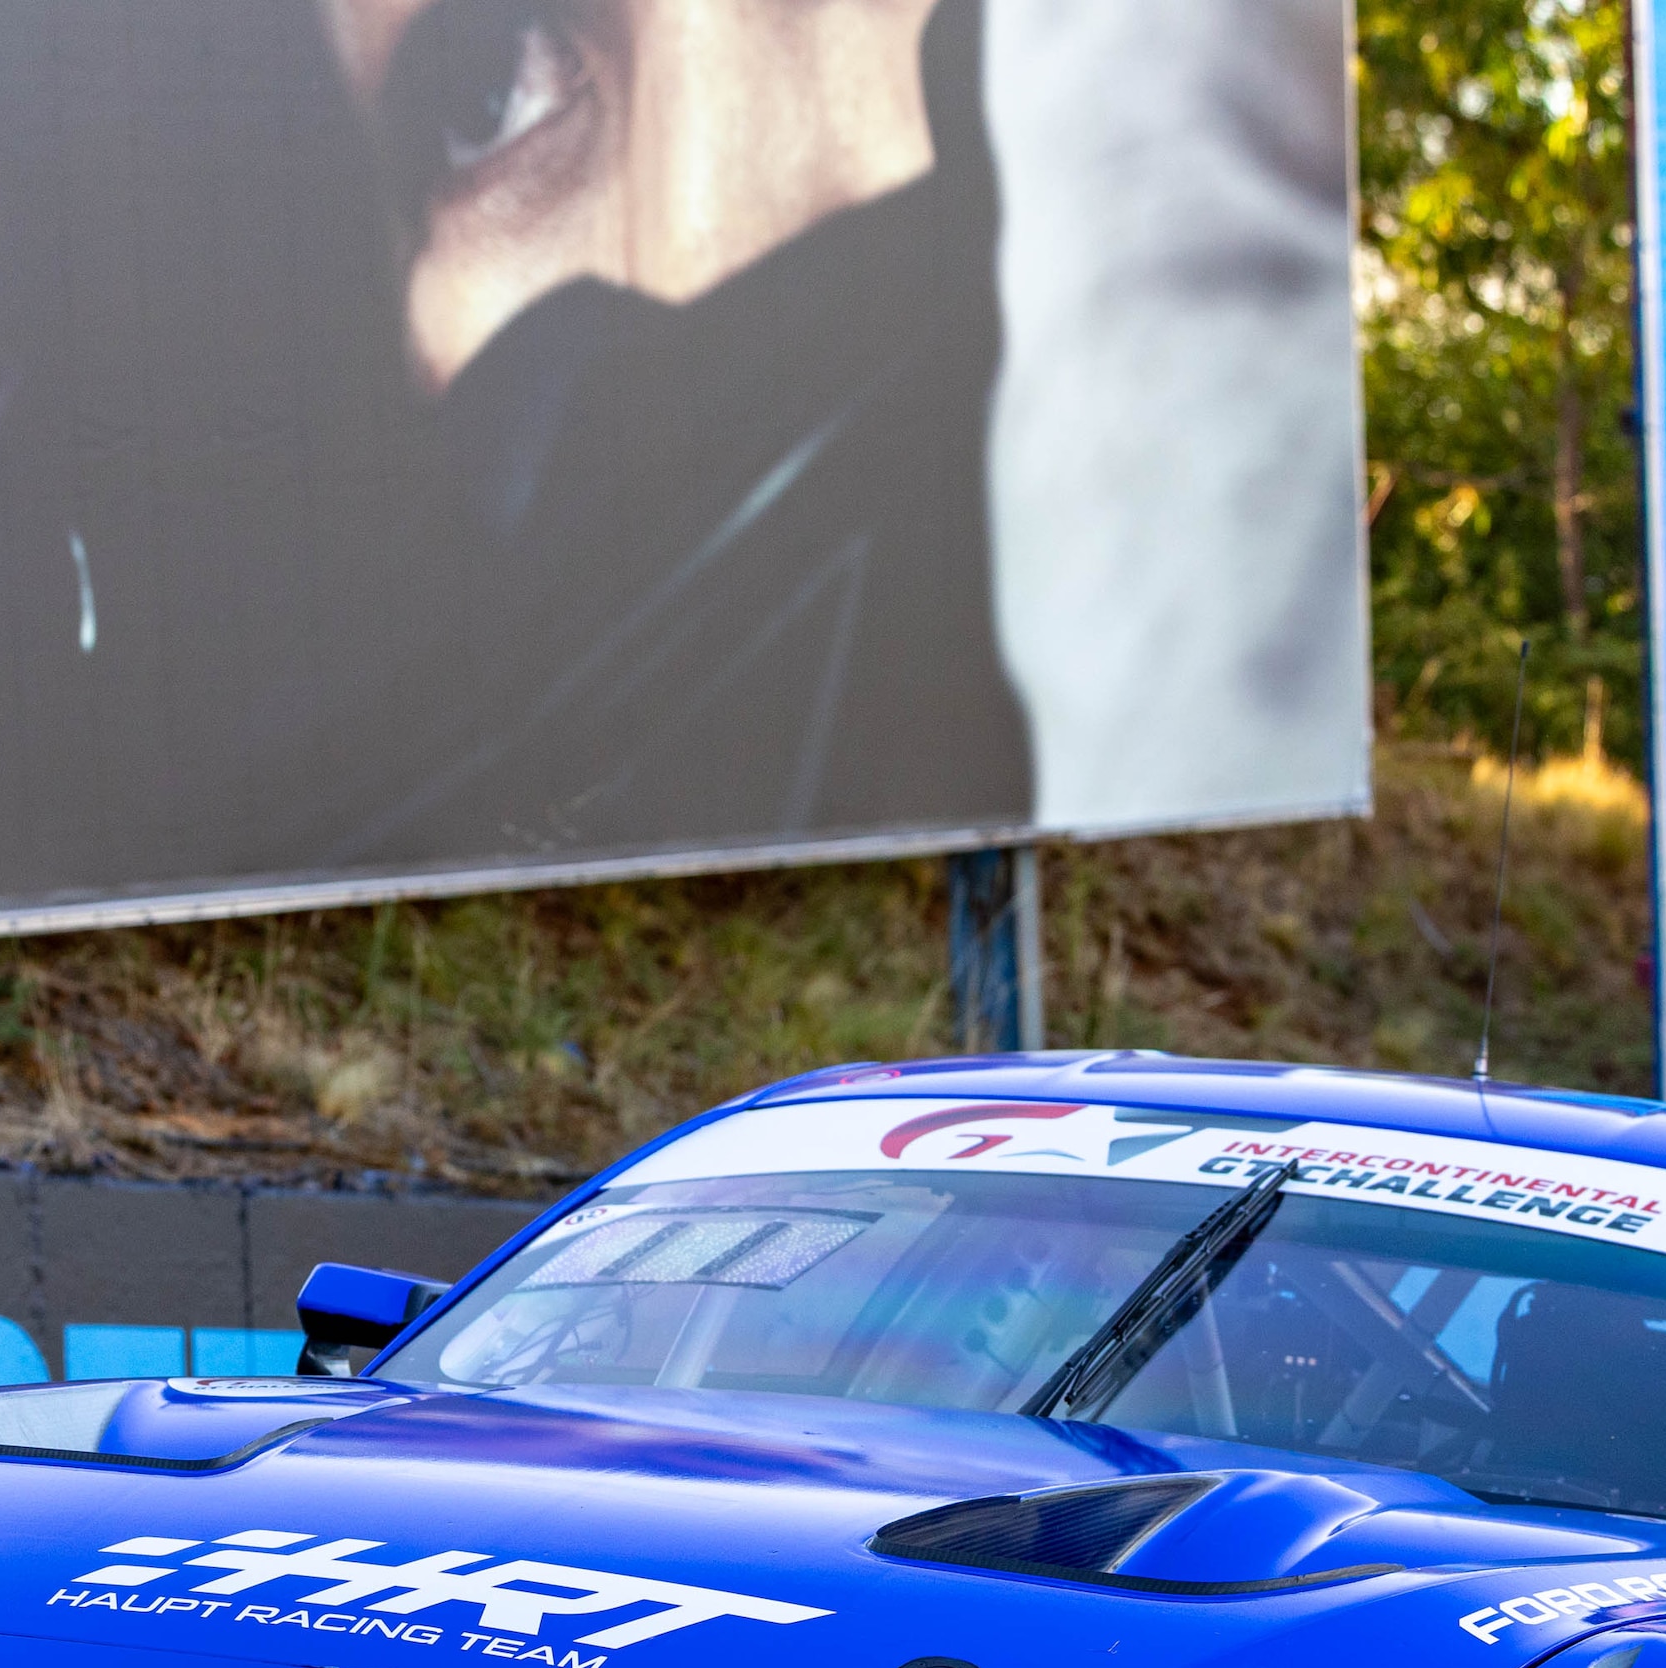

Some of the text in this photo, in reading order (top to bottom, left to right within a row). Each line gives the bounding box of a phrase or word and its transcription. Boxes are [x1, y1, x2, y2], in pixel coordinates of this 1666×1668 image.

[1198, 1157, 1653, 1233] GT CHALLENGE
[1223, 1141, 1662, 1214] INTERCONTINENTAL
[47, 1589, 235, 1618] HAUPT
[238, 1605, 445, 1646] RACING
[1459, 1582, 1633, 1645] FORD
